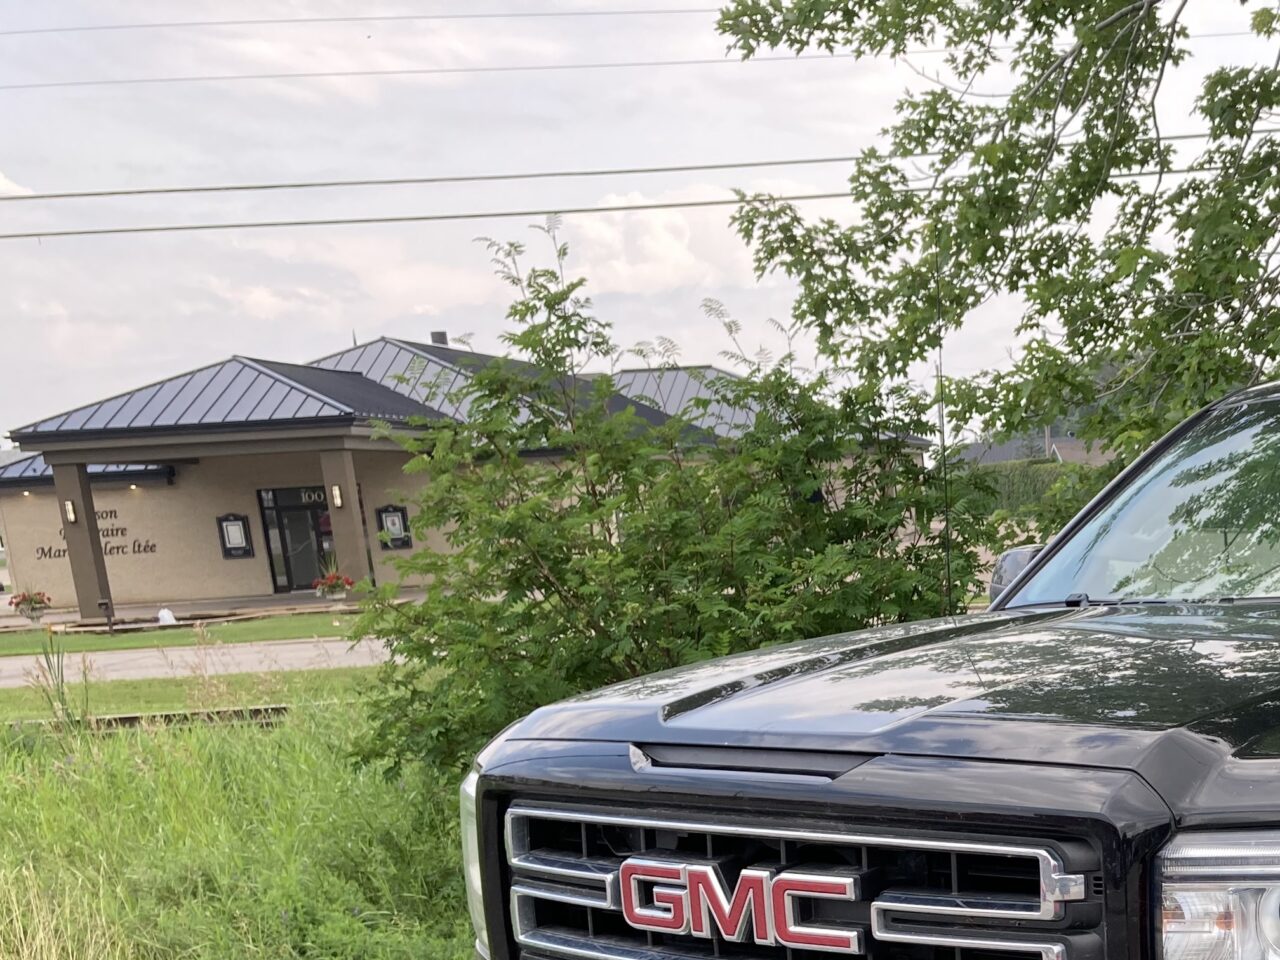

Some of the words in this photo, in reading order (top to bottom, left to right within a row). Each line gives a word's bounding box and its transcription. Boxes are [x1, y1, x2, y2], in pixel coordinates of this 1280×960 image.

[300, 489, 324, 505] 100
[36, 546, 68, 561] Mar
[104, 541, 128, 556] lerc
[619, 857, 861, 955] GMC
